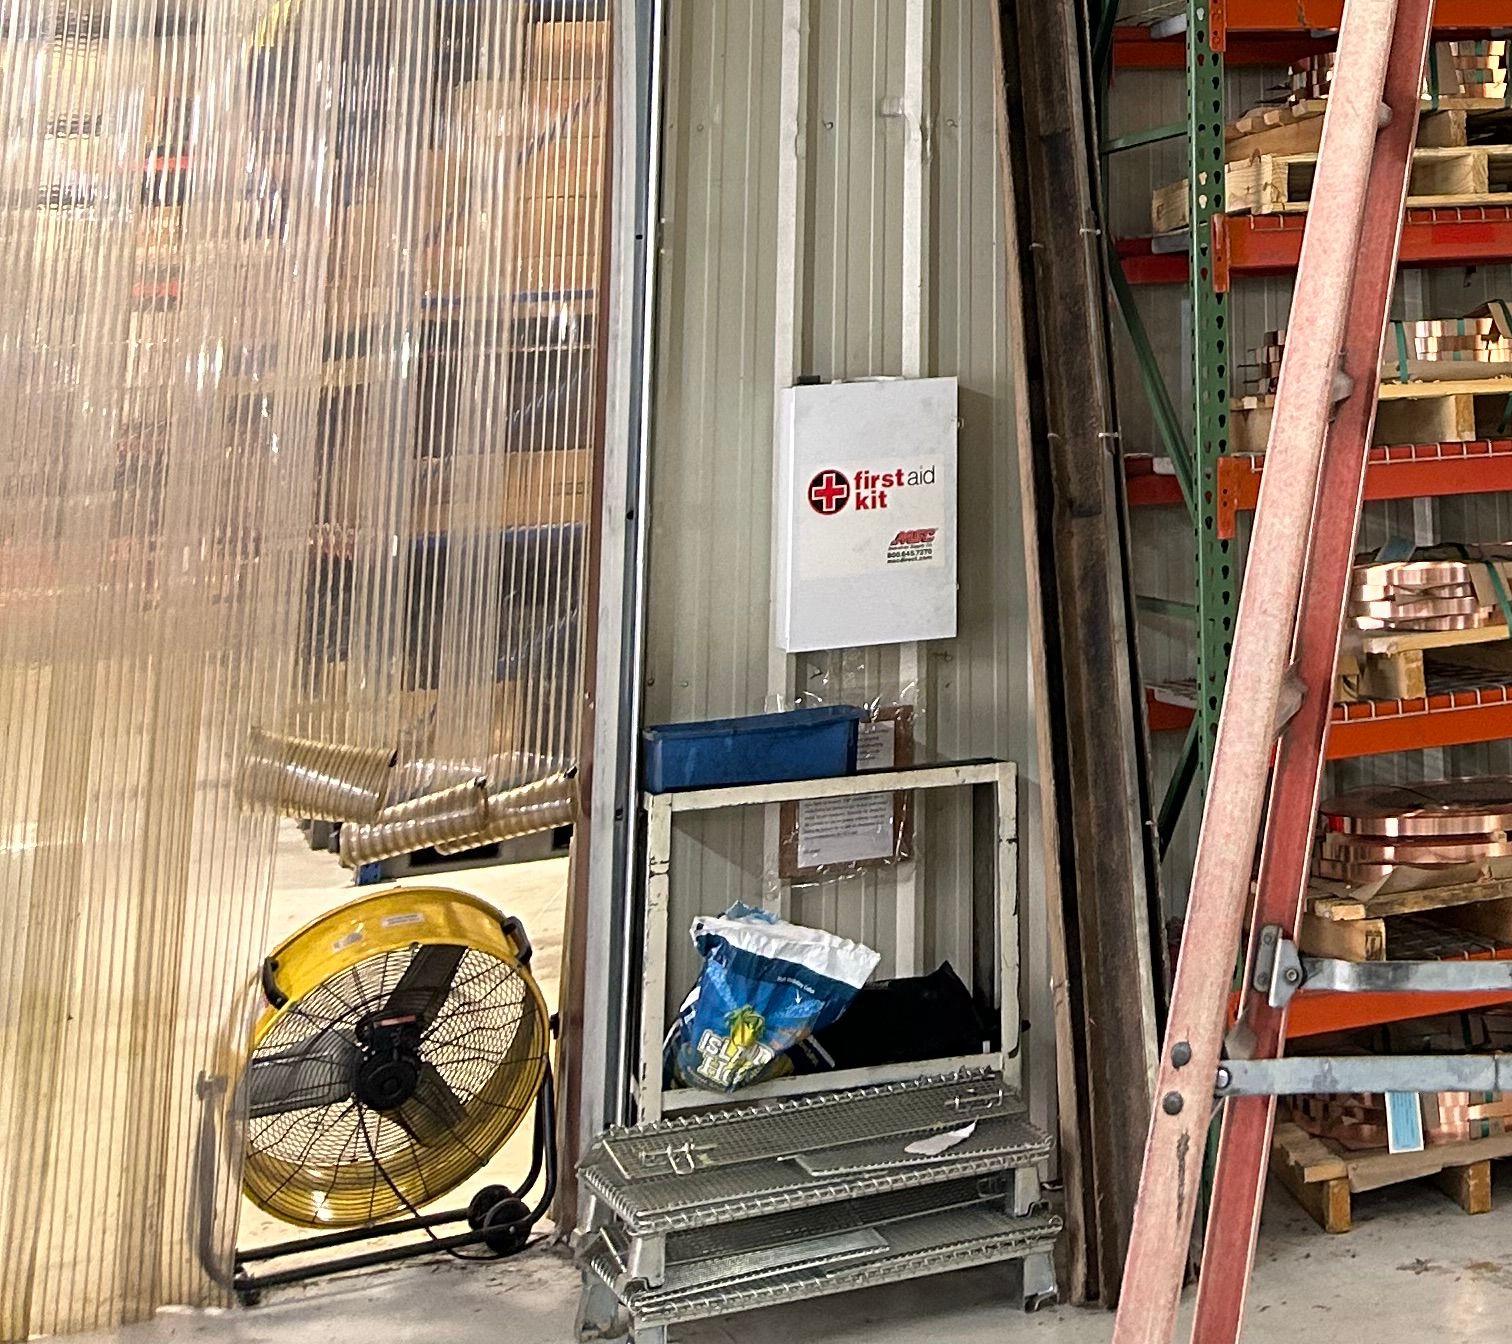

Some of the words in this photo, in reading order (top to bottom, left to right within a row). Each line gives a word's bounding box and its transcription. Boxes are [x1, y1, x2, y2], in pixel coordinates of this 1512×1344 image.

[854, 469, 904, 490] first
[907, 464, 935, 486] aid
[855, 489, 888, 511] kit
